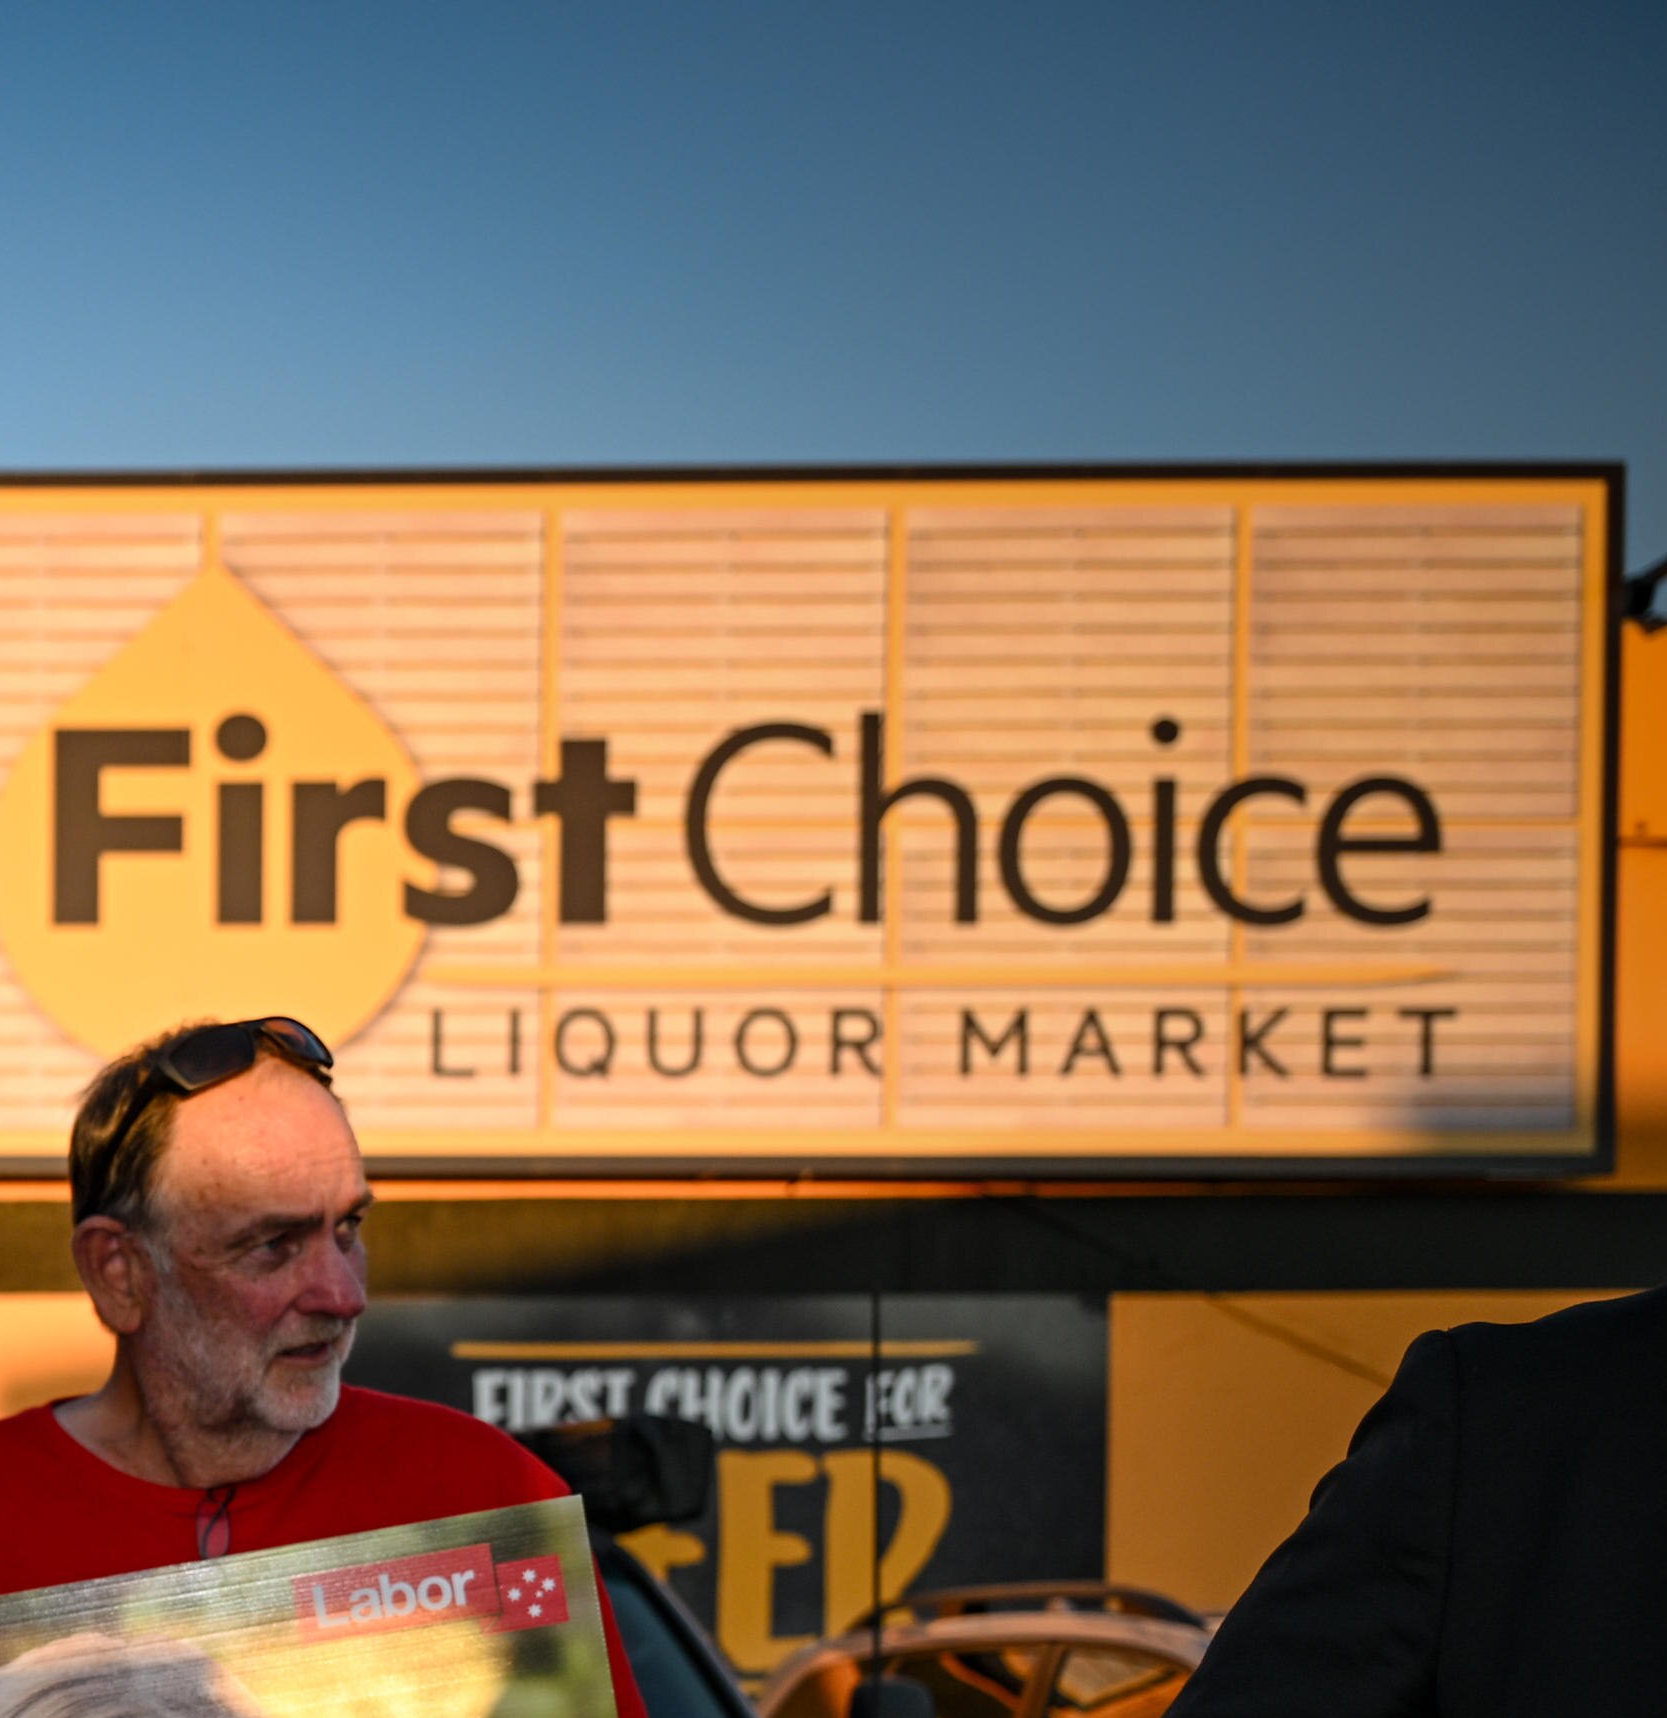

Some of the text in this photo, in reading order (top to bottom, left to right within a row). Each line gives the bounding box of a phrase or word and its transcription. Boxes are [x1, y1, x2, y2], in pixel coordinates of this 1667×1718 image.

[53, 712, 1443, 926] First Choice
[431, 1007, 1457, 1079] LIQUOR MARKET
[472, 1362, 956, 1442] FIRST CHOICE FOR
[311, 1568, 476, 1629] Labor
